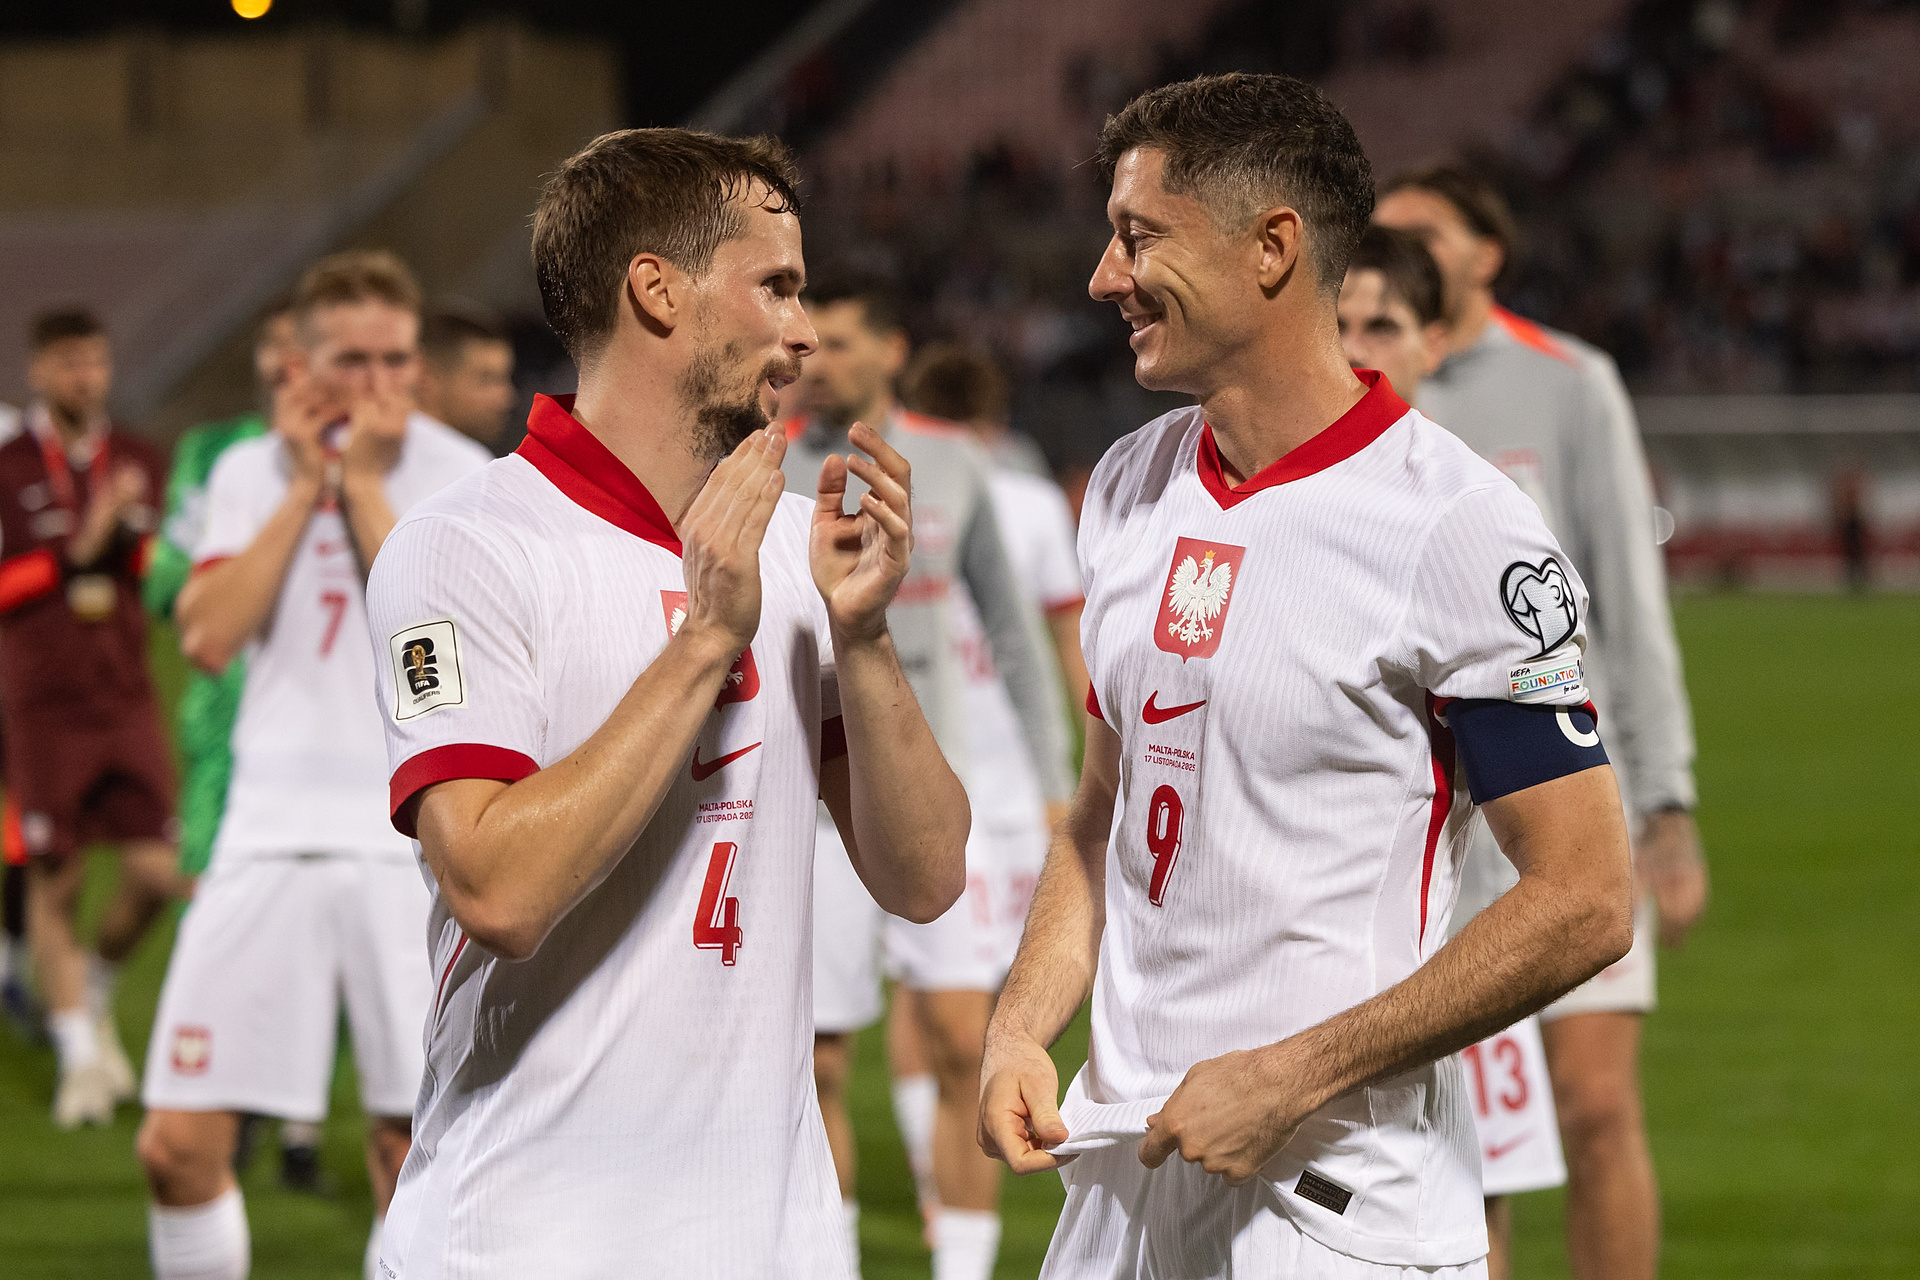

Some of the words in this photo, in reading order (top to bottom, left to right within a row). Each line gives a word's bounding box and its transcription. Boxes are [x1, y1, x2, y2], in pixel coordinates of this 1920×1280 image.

[319, 589, 349, 659] 7
[1510, 667, 1531, 678] UEFA
[1511, 669, 1578, 692] FOUNDATION
[414, 680, 430, 689] FIFA
[1148, 743, 1195, 760] MALTA-POLSKA
[1144, 755, 1152, 763] 17
[1153, 756, 1180, 768] LISTOPADA
[1181, 761, 1196, 772] 2025
[698, 799, 754, 812] MALTA-POLSKA
[696, 815, 702, 824] 17
[703, 812, 738, 824] LISTOPADA
[1147, 784, 1184, 907] 9
[693, 842, 742, 966] 4
[1462, 1037, 1529, 1118] 13
